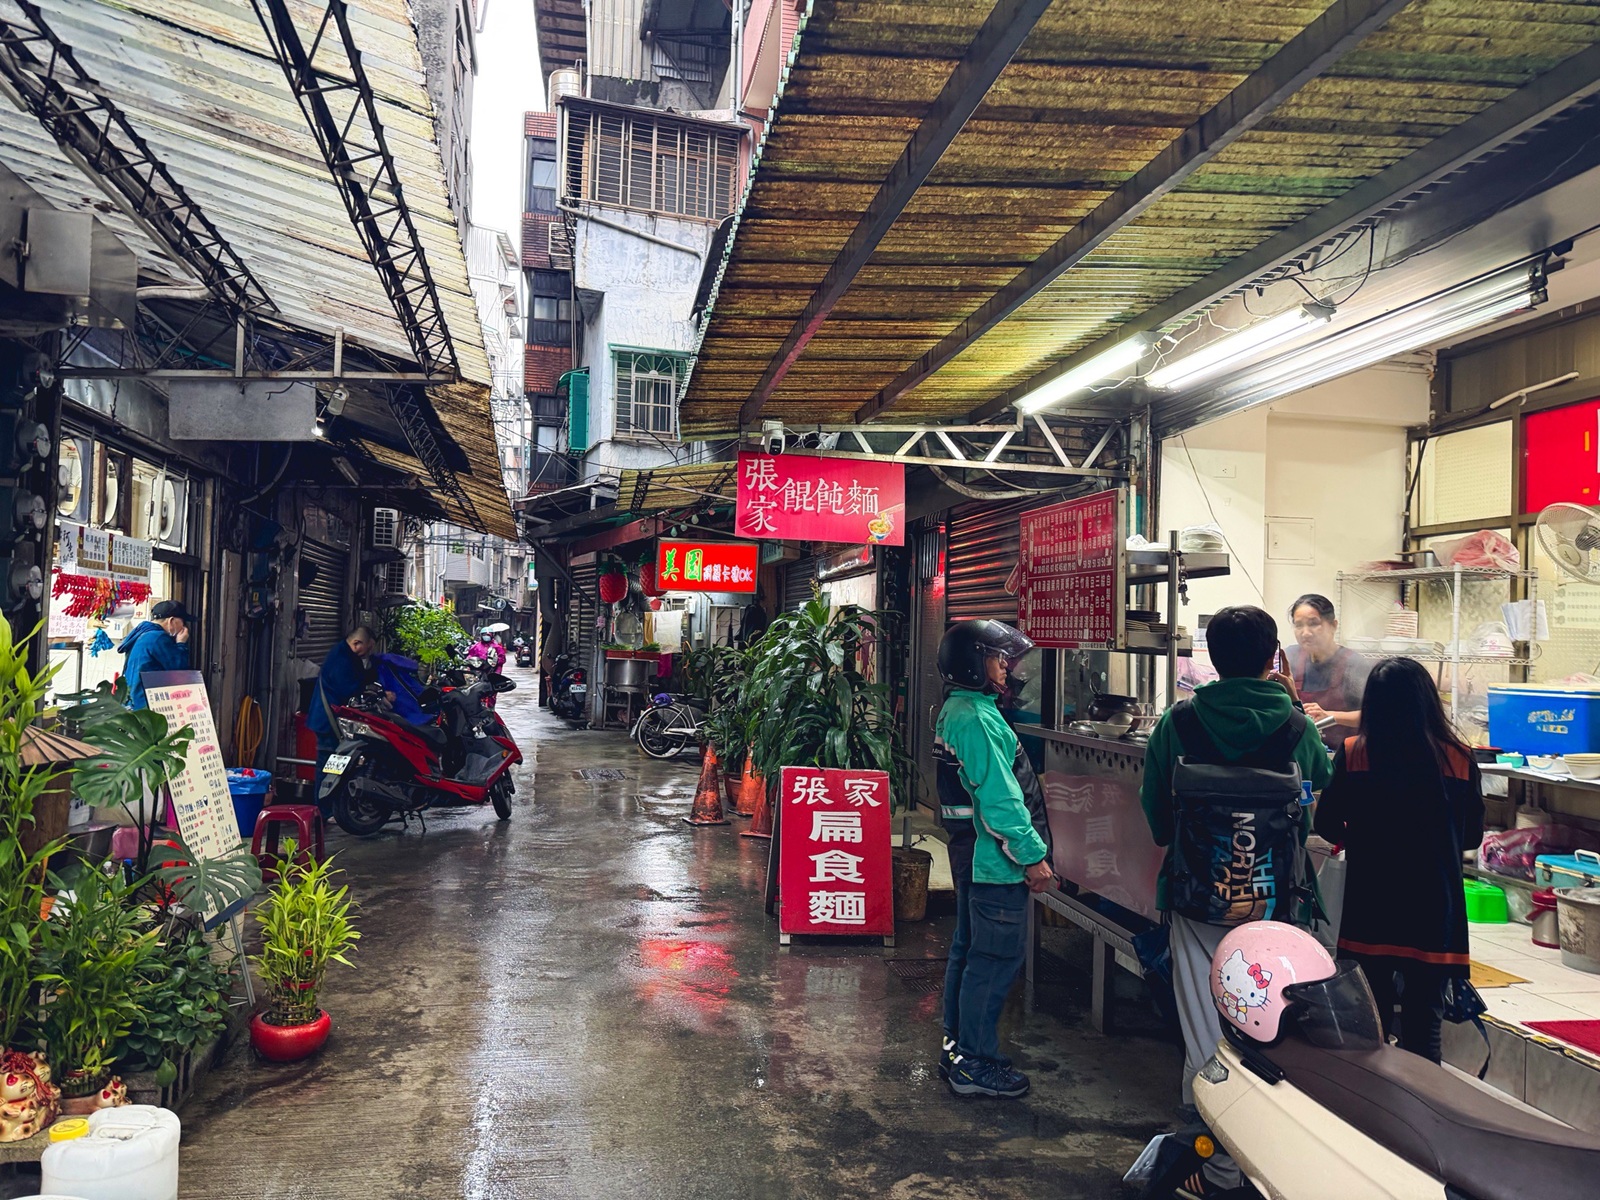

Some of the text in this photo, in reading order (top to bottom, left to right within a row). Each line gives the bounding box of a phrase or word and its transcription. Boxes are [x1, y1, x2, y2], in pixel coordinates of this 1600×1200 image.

[745, 458, 779, 532] 張家
[775, 477, 879, 517] 餛飩麵
[792, 776, 882, 807] 張家
[808, 811, 866, 925] 扁食麵
[1210, 834, 1232, 901] FACE
[1232, 812, 1256, 904] NORTH
[1252, 848, 1276, 900] THE
